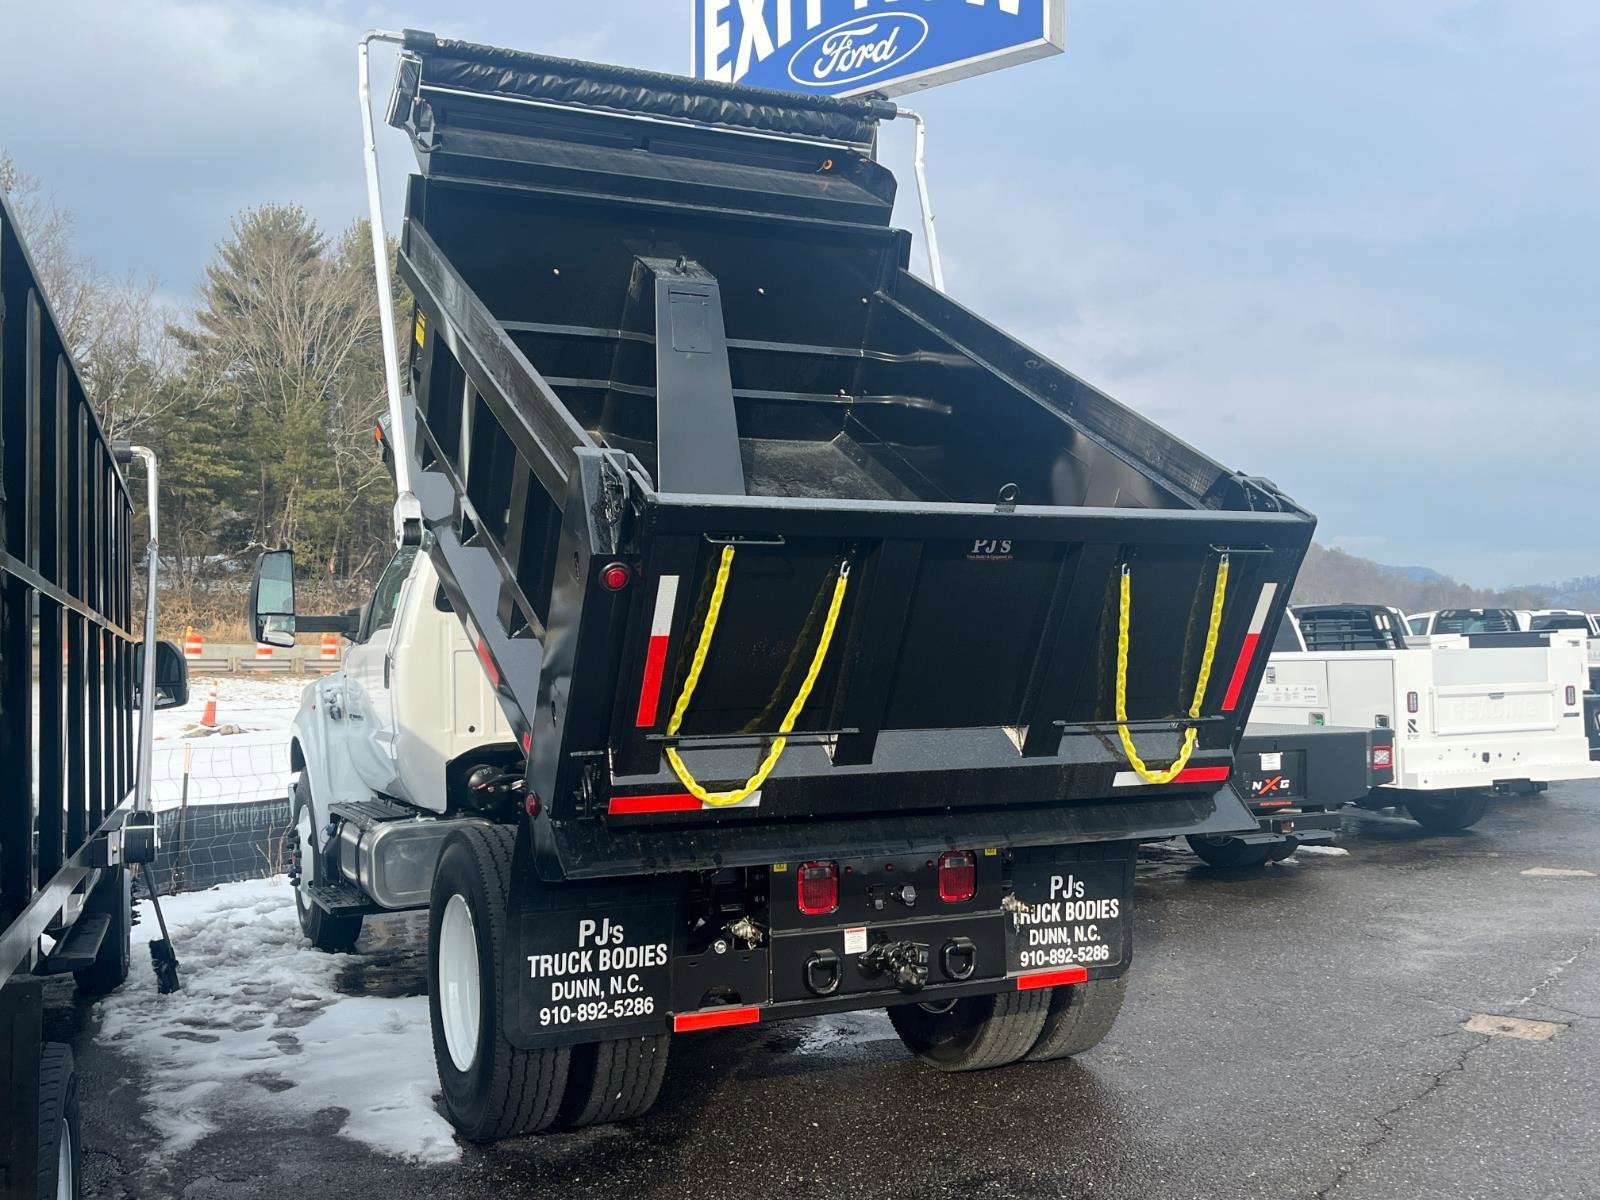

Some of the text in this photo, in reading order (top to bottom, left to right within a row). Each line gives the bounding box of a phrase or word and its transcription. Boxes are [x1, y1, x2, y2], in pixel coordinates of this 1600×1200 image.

[813, 24, 900, 79] Ford
[1251, 776, 1290, 795] NXG
[1050, 874, 1085, 900] PJ's
[1065, 898, 1120, 922] BODIES
[578, 918, 624, 947] PJ's
[1029, 924, 1101, 946] DUNN, N.C.
[527, 943, 668, 979] TRUCK BODIES
[1019, 944, 1110, 968] 910-892-5286
[551, 973, 644, 1001] DUNN, N.C.
[539, 996, 655, 1026] 910-892-5286
